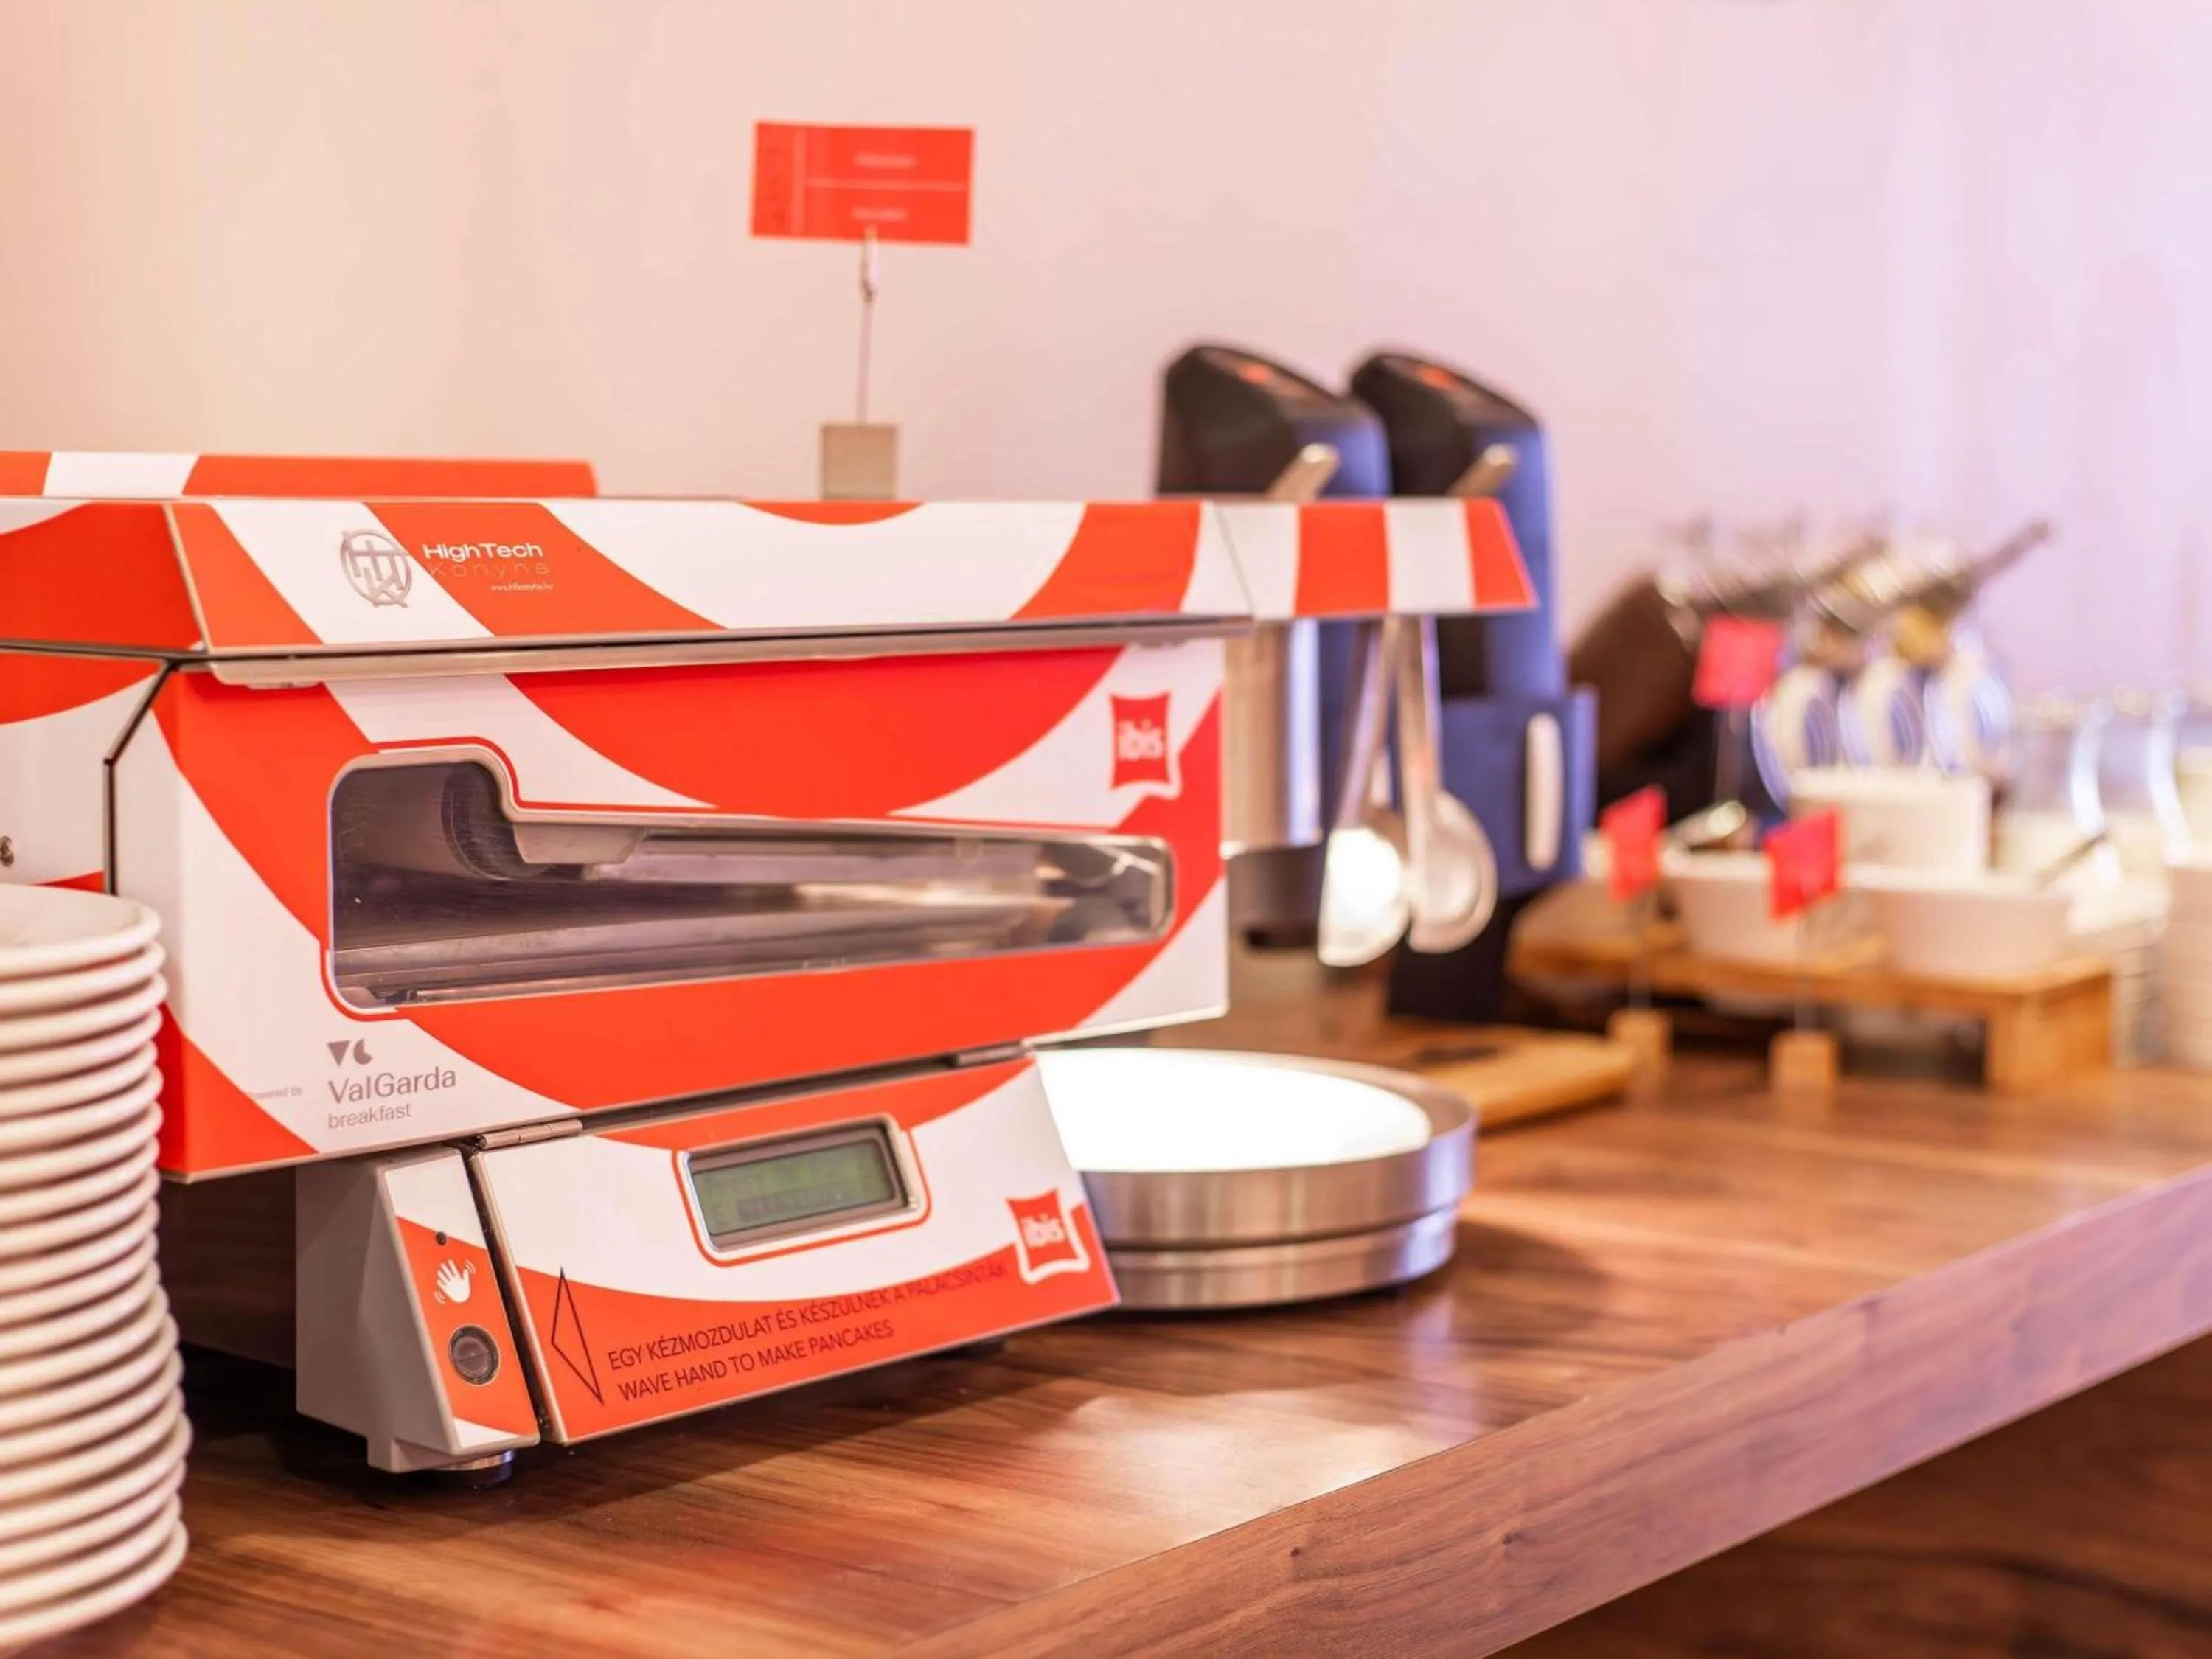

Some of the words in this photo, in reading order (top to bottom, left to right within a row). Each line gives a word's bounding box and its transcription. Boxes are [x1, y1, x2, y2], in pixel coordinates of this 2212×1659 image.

[421, 542, 544, 563] HighTech
[1117, 718, 1164, 761] ibis
[327, 1065, 457, 1105] ValGarda
[327, 1103, 413, 1130] breakfast
[1020, 1212, 1065, 1248] ibis
[608, 1345, 642, 1371] EGY
[646, 1315, 773, 1360] KÉZMOZDULAT
[776, 1308, 798, 1331] ÉS
[894, 1286, 905, 1304] A
[618, 1371, 674, 1401] WAVE
[674, 1360, 728, 1387] HAND
[728, 1352, 755, 1374] TO
[757, 1340, 807, 1367] MAKE
[808, 1318, 895, 1355] PANCAKES
